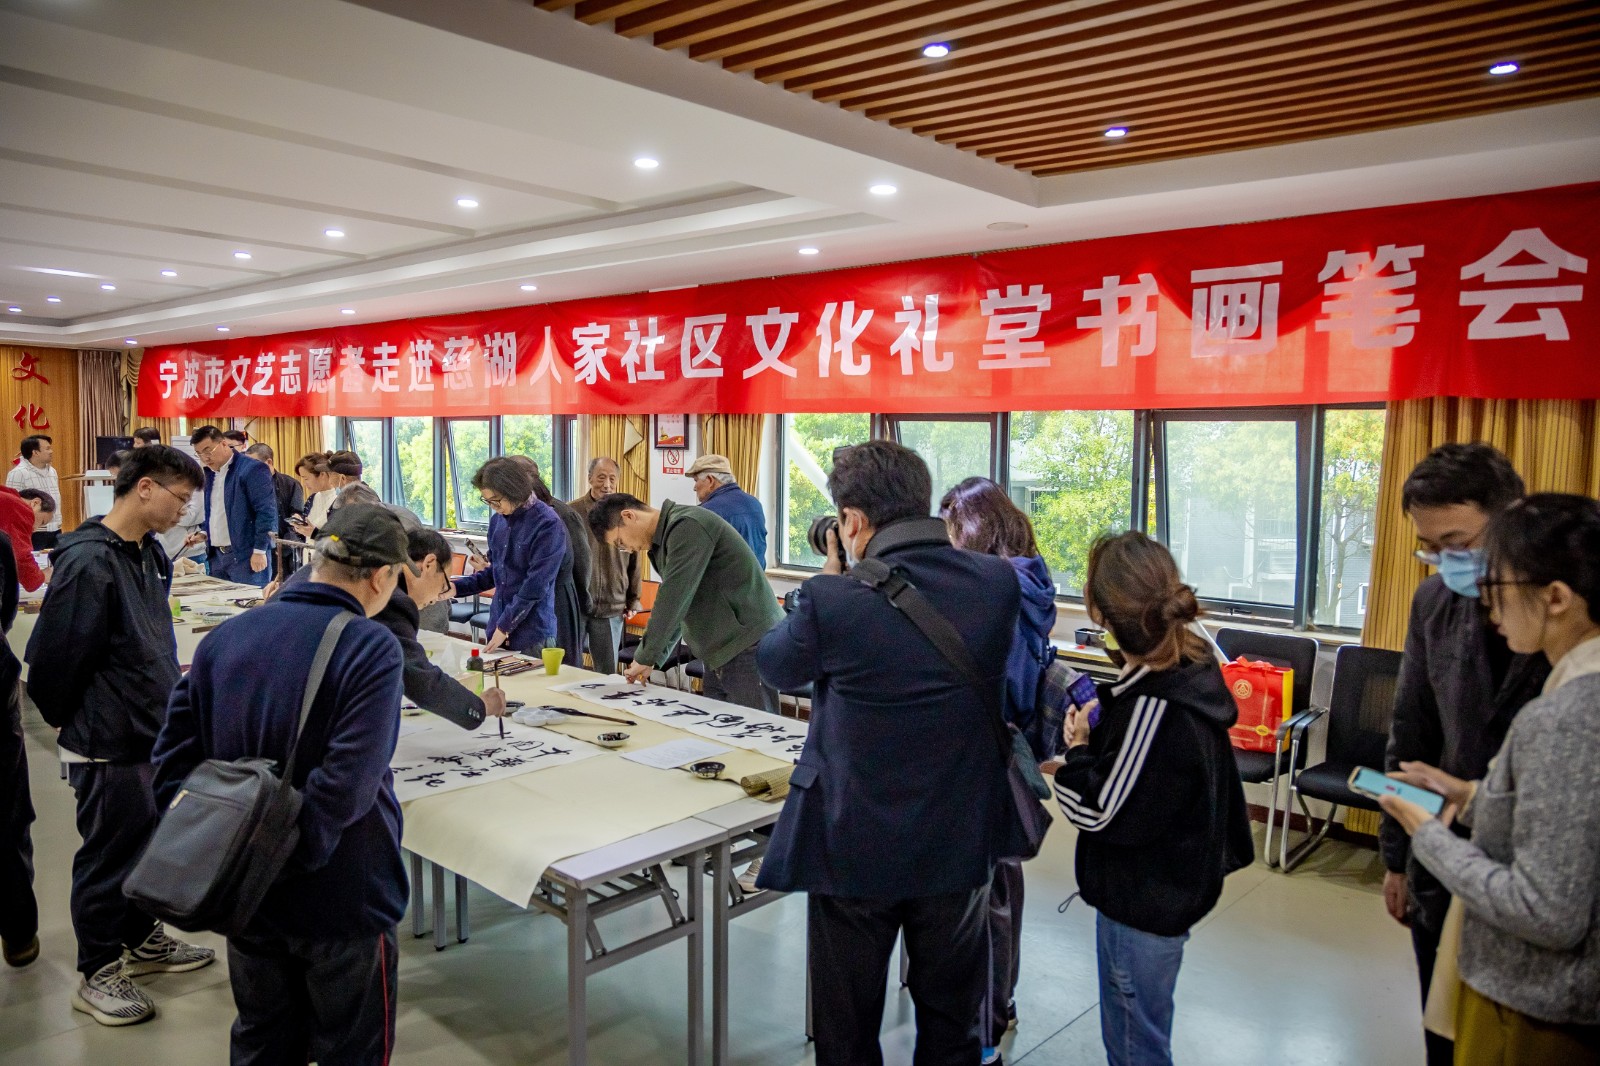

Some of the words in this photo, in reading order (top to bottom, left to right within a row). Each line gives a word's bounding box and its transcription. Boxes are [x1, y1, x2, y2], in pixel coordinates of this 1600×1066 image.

[159, 228, 1588, 398] 宁波市文艺志愿者走进慈湖人家社区文化礼堂书画笔会
[12, 351, 50, 465] 文化
